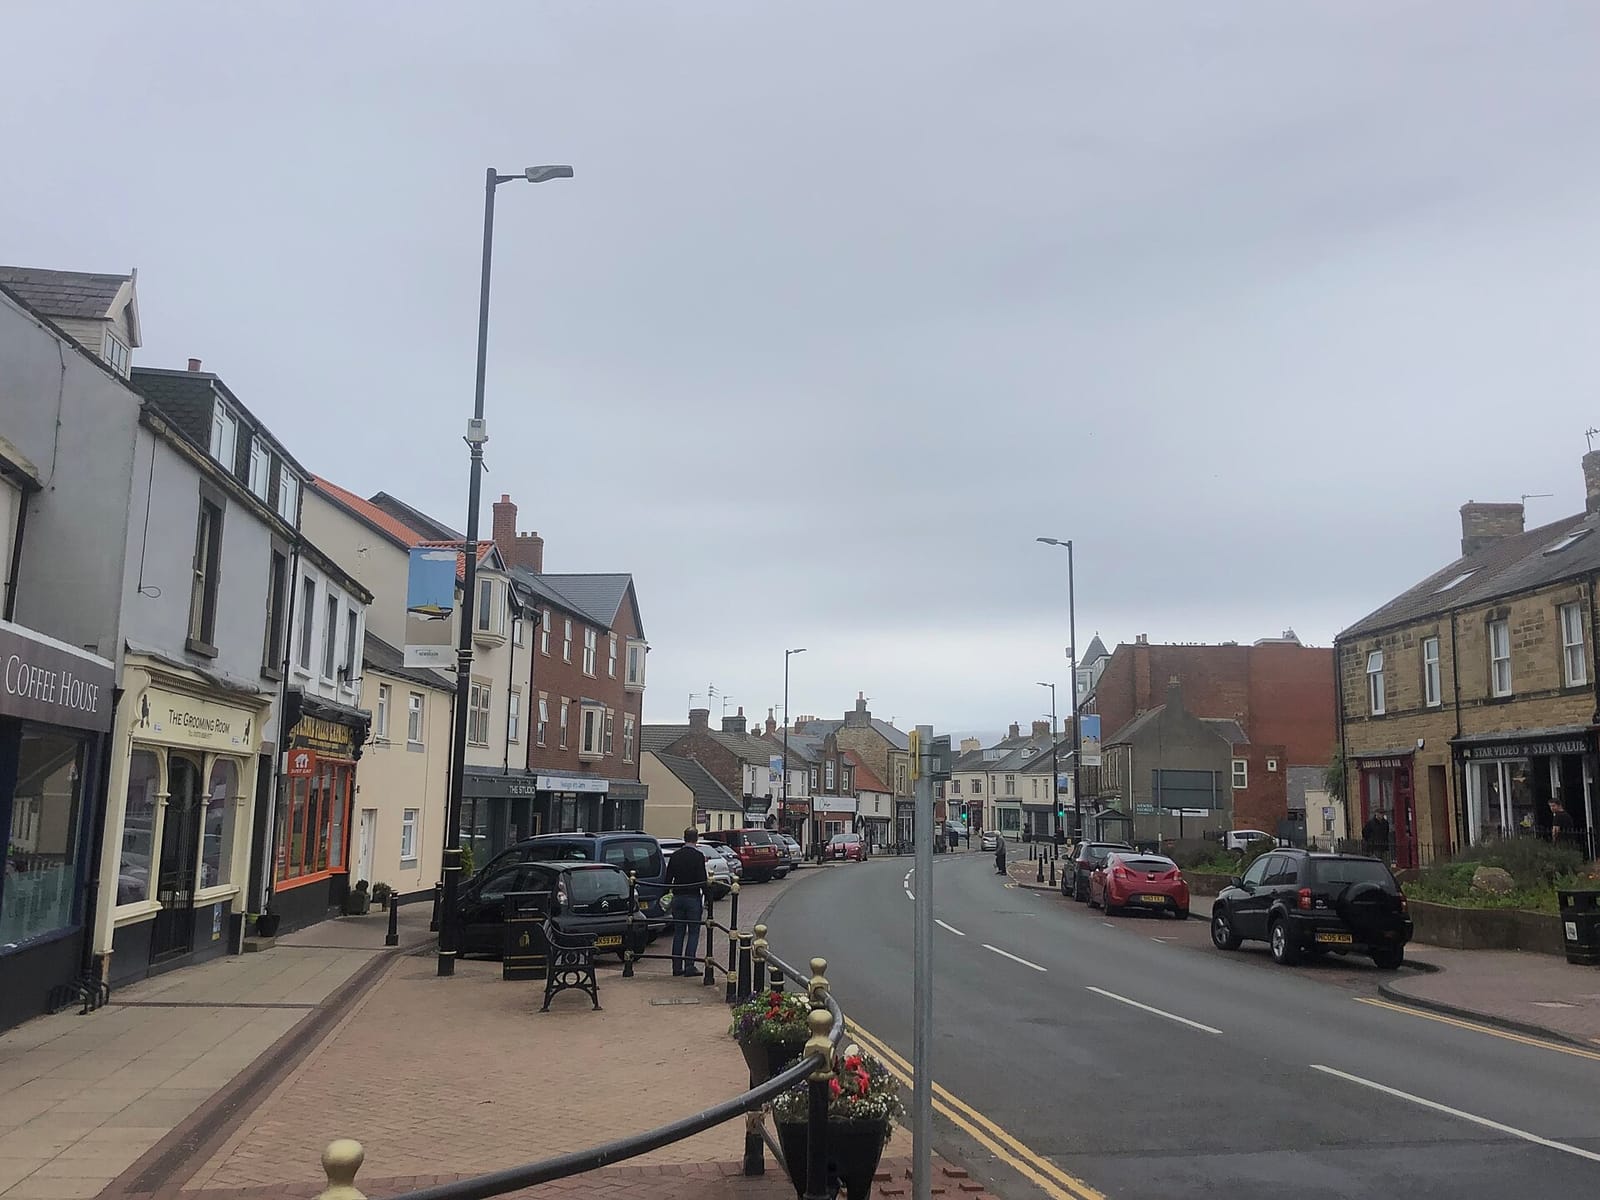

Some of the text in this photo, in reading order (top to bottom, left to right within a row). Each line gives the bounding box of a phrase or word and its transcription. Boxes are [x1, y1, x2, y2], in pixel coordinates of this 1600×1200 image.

[6, 655, 99, 713] COFFEE HOUSE
[1474, 741, 1586, 758] STAR VIDEO STAR VALUE
